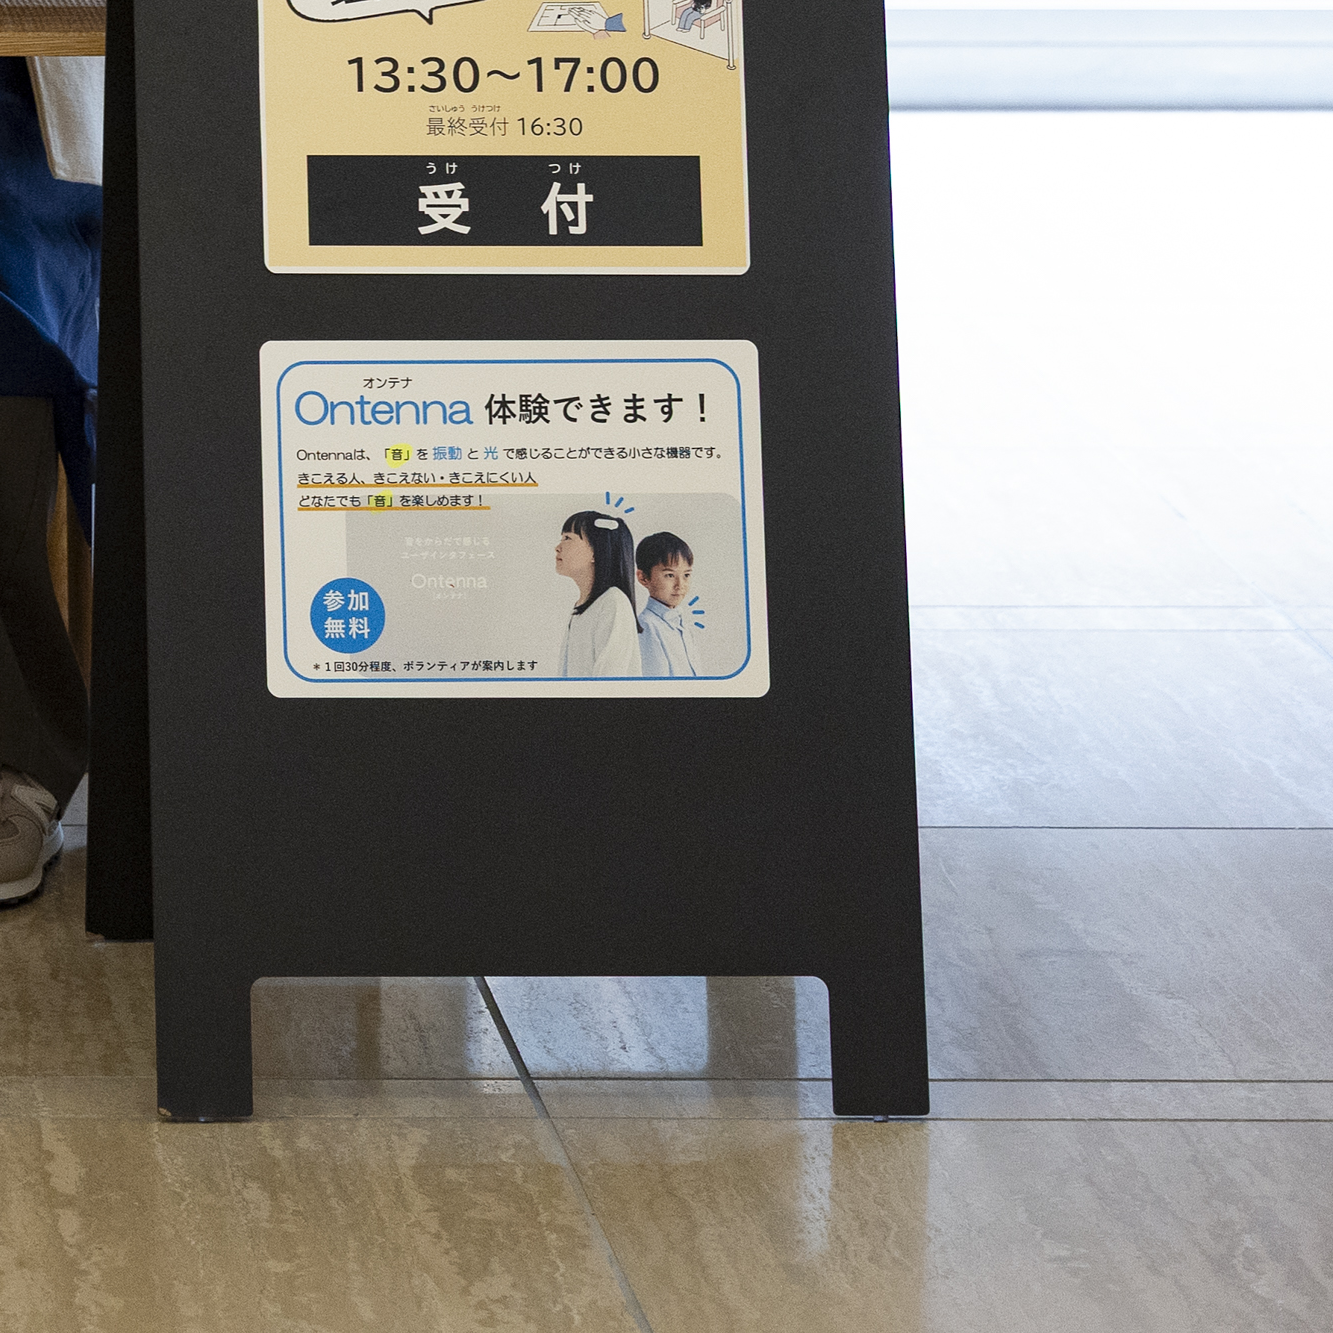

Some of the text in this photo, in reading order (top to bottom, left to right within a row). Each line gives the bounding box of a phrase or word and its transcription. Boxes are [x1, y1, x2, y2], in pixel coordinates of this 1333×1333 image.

[426, 116, 583, 137] 最終受付 16:30
[426, 162, 582, 175] うけ つけ
[363, 377, 413, 389] オンテナ
[294, 390, 707, 426] Ontenna 体験できます！
[412, 573, 487, 588] Ontenna
[323, 589, 369, 611] 参加
[324, 617, 370, 639] 無料
